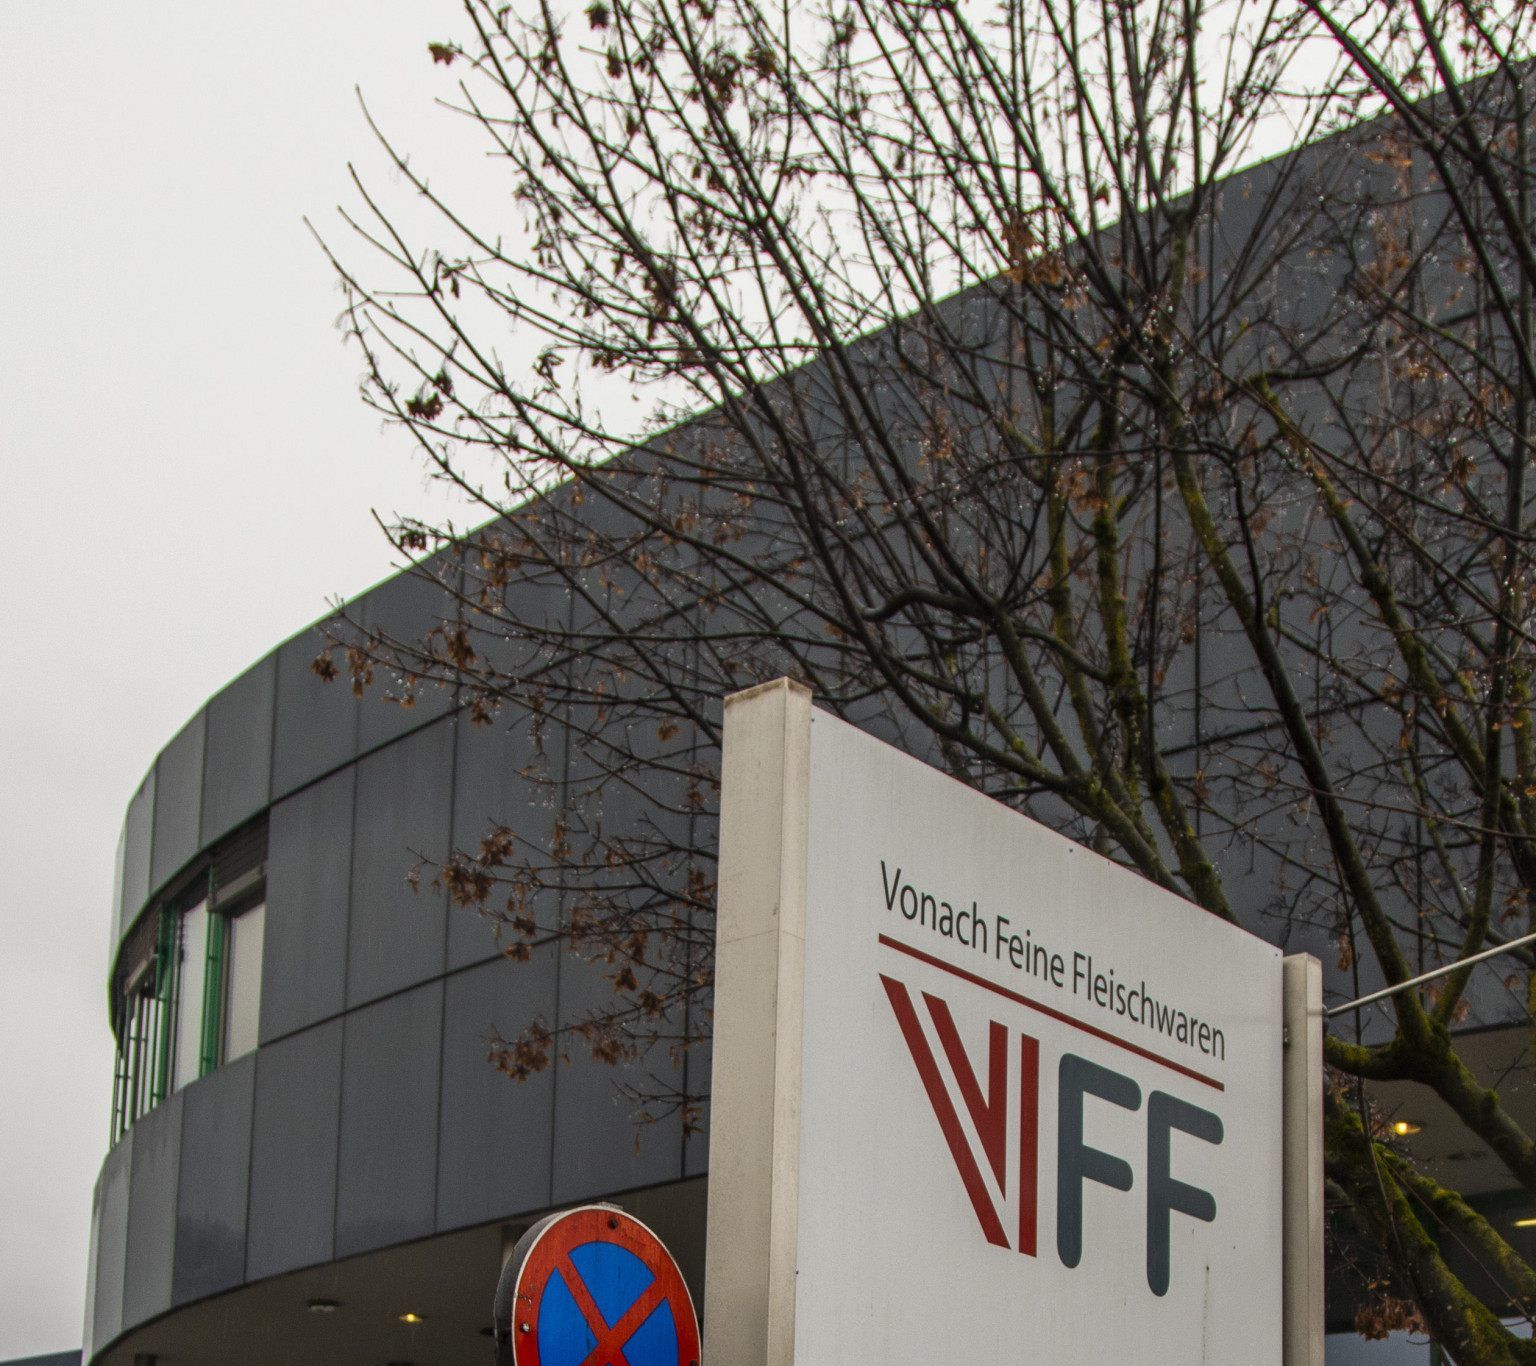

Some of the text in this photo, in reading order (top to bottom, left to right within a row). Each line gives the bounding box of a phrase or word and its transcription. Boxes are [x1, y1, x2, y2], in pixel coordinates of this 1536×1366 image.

[880, 860, 1226, 1061] Vonach Feine Fleischwaren
[878, 972, 1225, 1297] VFF
